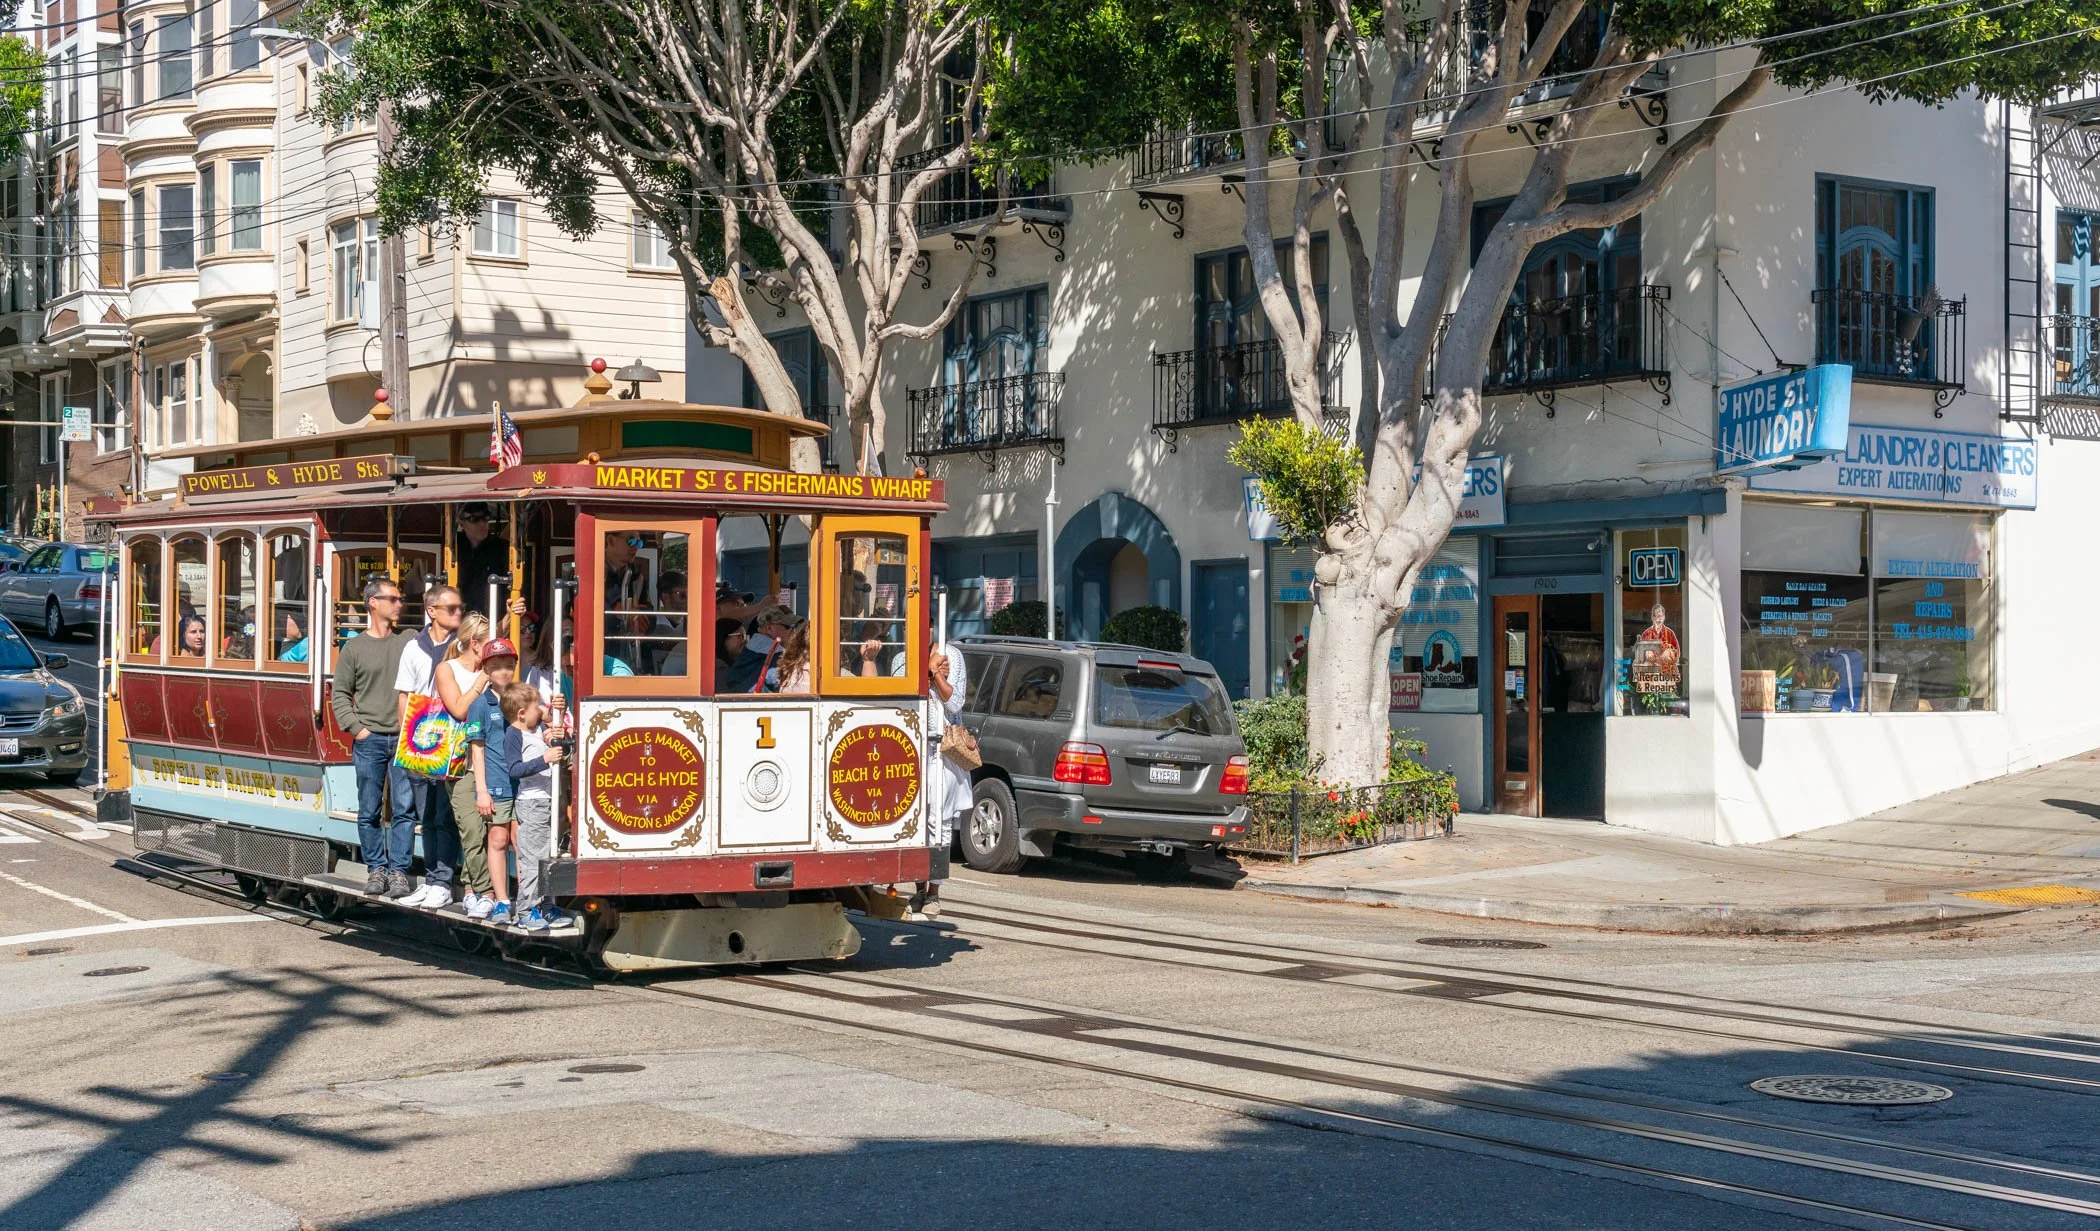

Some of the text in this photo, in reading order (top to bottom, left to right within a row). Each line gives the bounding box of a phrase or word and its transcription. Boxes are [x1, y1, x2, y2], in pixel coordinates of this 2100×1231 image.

[1733, 377, 1808, 420] HYDE ST.
[1722, 406, 1818, 464] LAUNDRY
[1845, 434, 2034, 476] LAUNDRY & CLEANERS
[186, 461, 383, 492] POWELL & HYDE Sts.
[596, 466, 932, 499] MARKET ST & FISHERMANS WHARF
[1838, 467, 1962, 494] EXPERT ALTERATIONS
[1635, 554, 1675, 580] OPEN
[1888, 560, 1978, 578] EXPERT ALTERATION
[1534, 578, 1558, 589] 1900
[1925, 582, 1943, 597] AND
[1915, 601, 1952, 618] REPAIRS
[1392, 679, 1419, 692] OPEN
[1422, 673, 1464, 683] Shoe Repairs
[1634, 673, 1680, 682] Alterations
[1741, 677, 1773, 692] OPEN
[1636, 683, 1676, 692] & Repairs
[1392, 695, 1418, 706] SUNDAY
[756, 717, 776, 749] 1
[599, 732, 697, 767] POWELL & MARKET
[832, 727, 916, 765] POWELL & MARKET
[640, 756, 656, 766] TO
[867, 752, 880, 762] TO
[152, 758, 304, 801] POWELL ST. RAILWAY CO.
[596, 771, 698, 788] BEACH & HYDE
[832, 763, 916, 784] BEACH & HYDE
[637, 795, 658, 804] VIA
[832, 779, 918, 822] WASHINGTON & JACKSON
[867, 788, 882, 797] VIA
[596, 790, 698, 829] WASHINGTON & JACKSON
